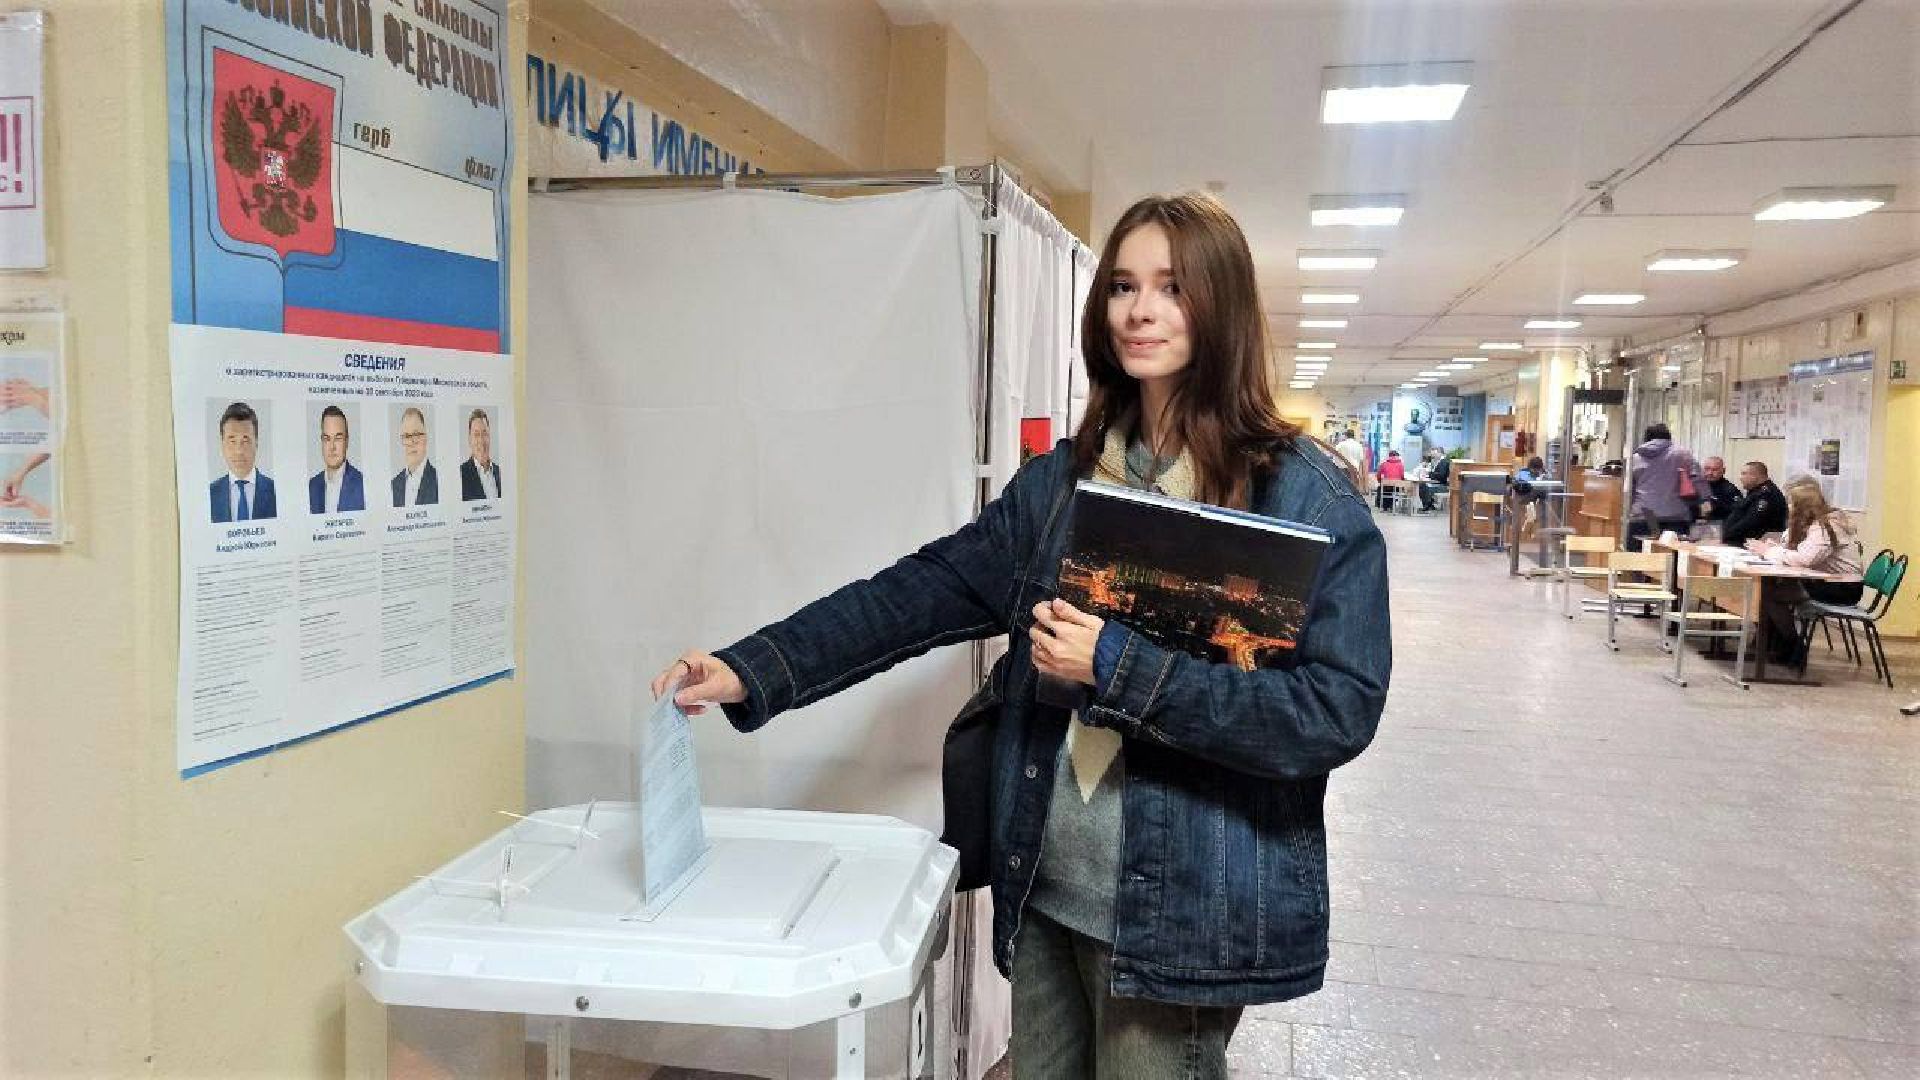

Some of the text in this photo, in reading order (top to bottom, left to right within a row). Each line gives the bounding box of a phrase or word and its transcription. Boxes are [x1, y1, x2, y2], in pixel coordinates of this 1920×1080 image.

[384, 11, 498, 109] ФЕДЕРАЦИИ
[353, 122, 391, 150] герб
[465, 156, 498, 181] флаг
[344, 353, 406, 371] СВЕДЕНИЯ
